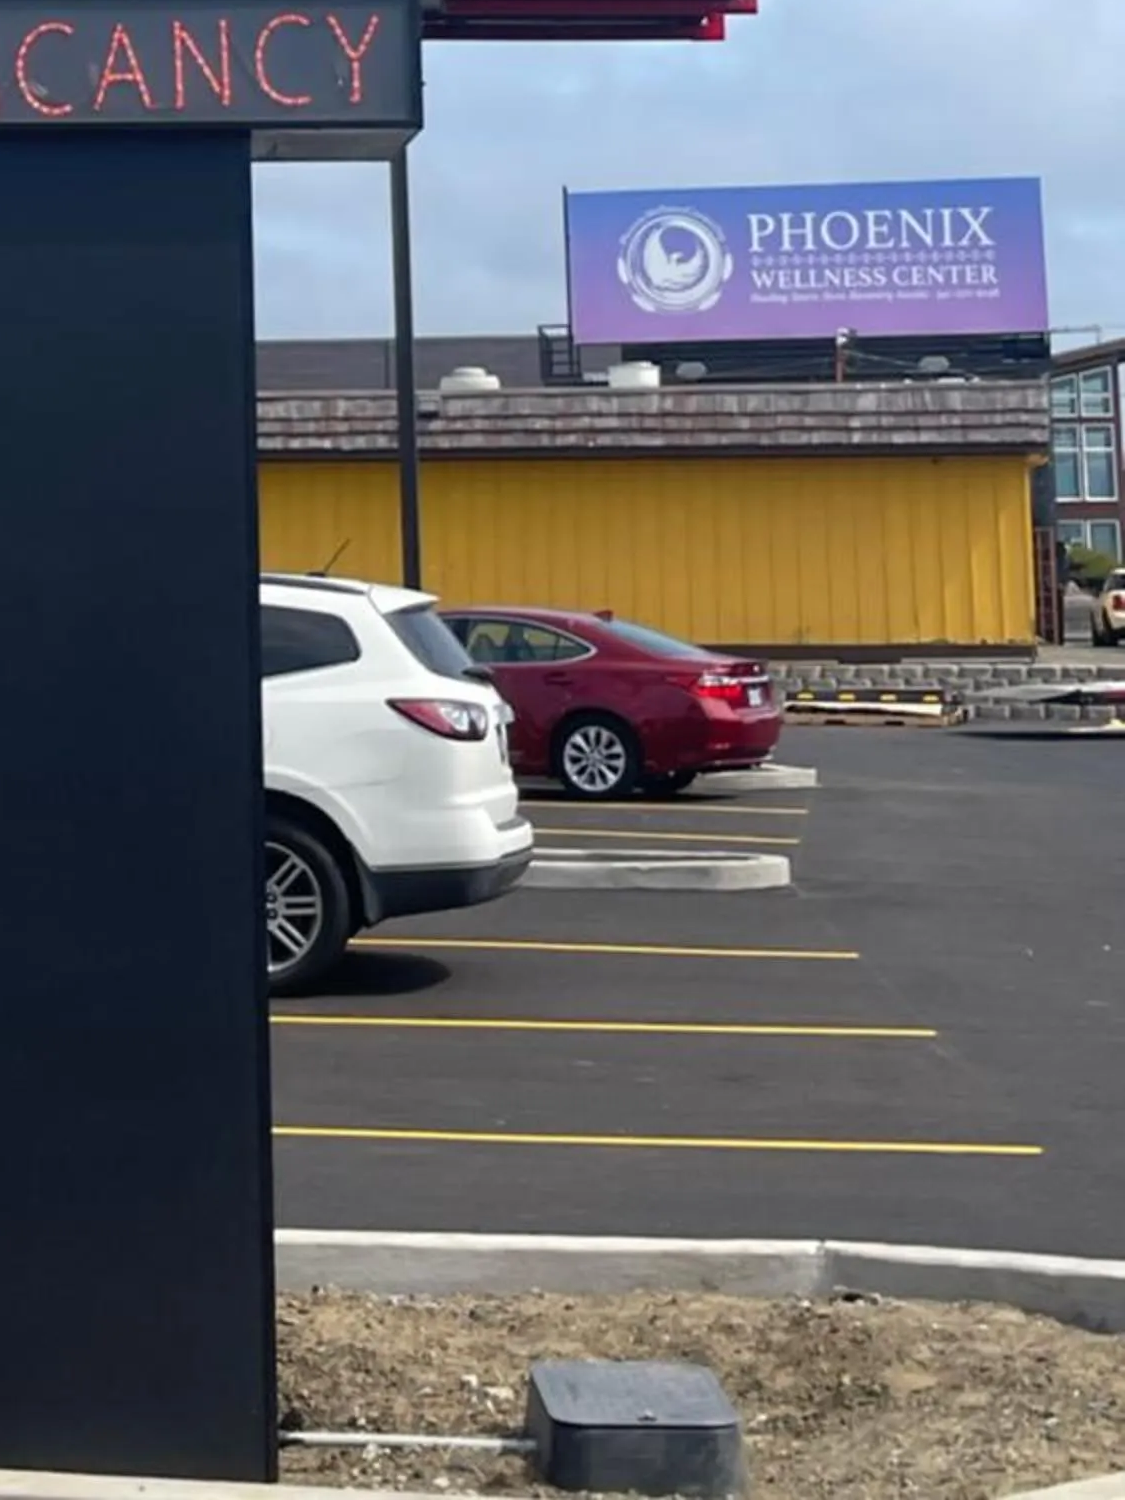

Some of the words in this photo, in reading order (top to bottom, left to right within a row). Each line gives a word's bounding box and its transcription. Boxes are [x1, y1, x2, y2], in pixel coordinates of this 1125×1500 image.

[747, 206, 997, 254] PHOENIX
[751, 266, 887, 290] WELLNESS
[891, 263, 999, 287] CENTER
